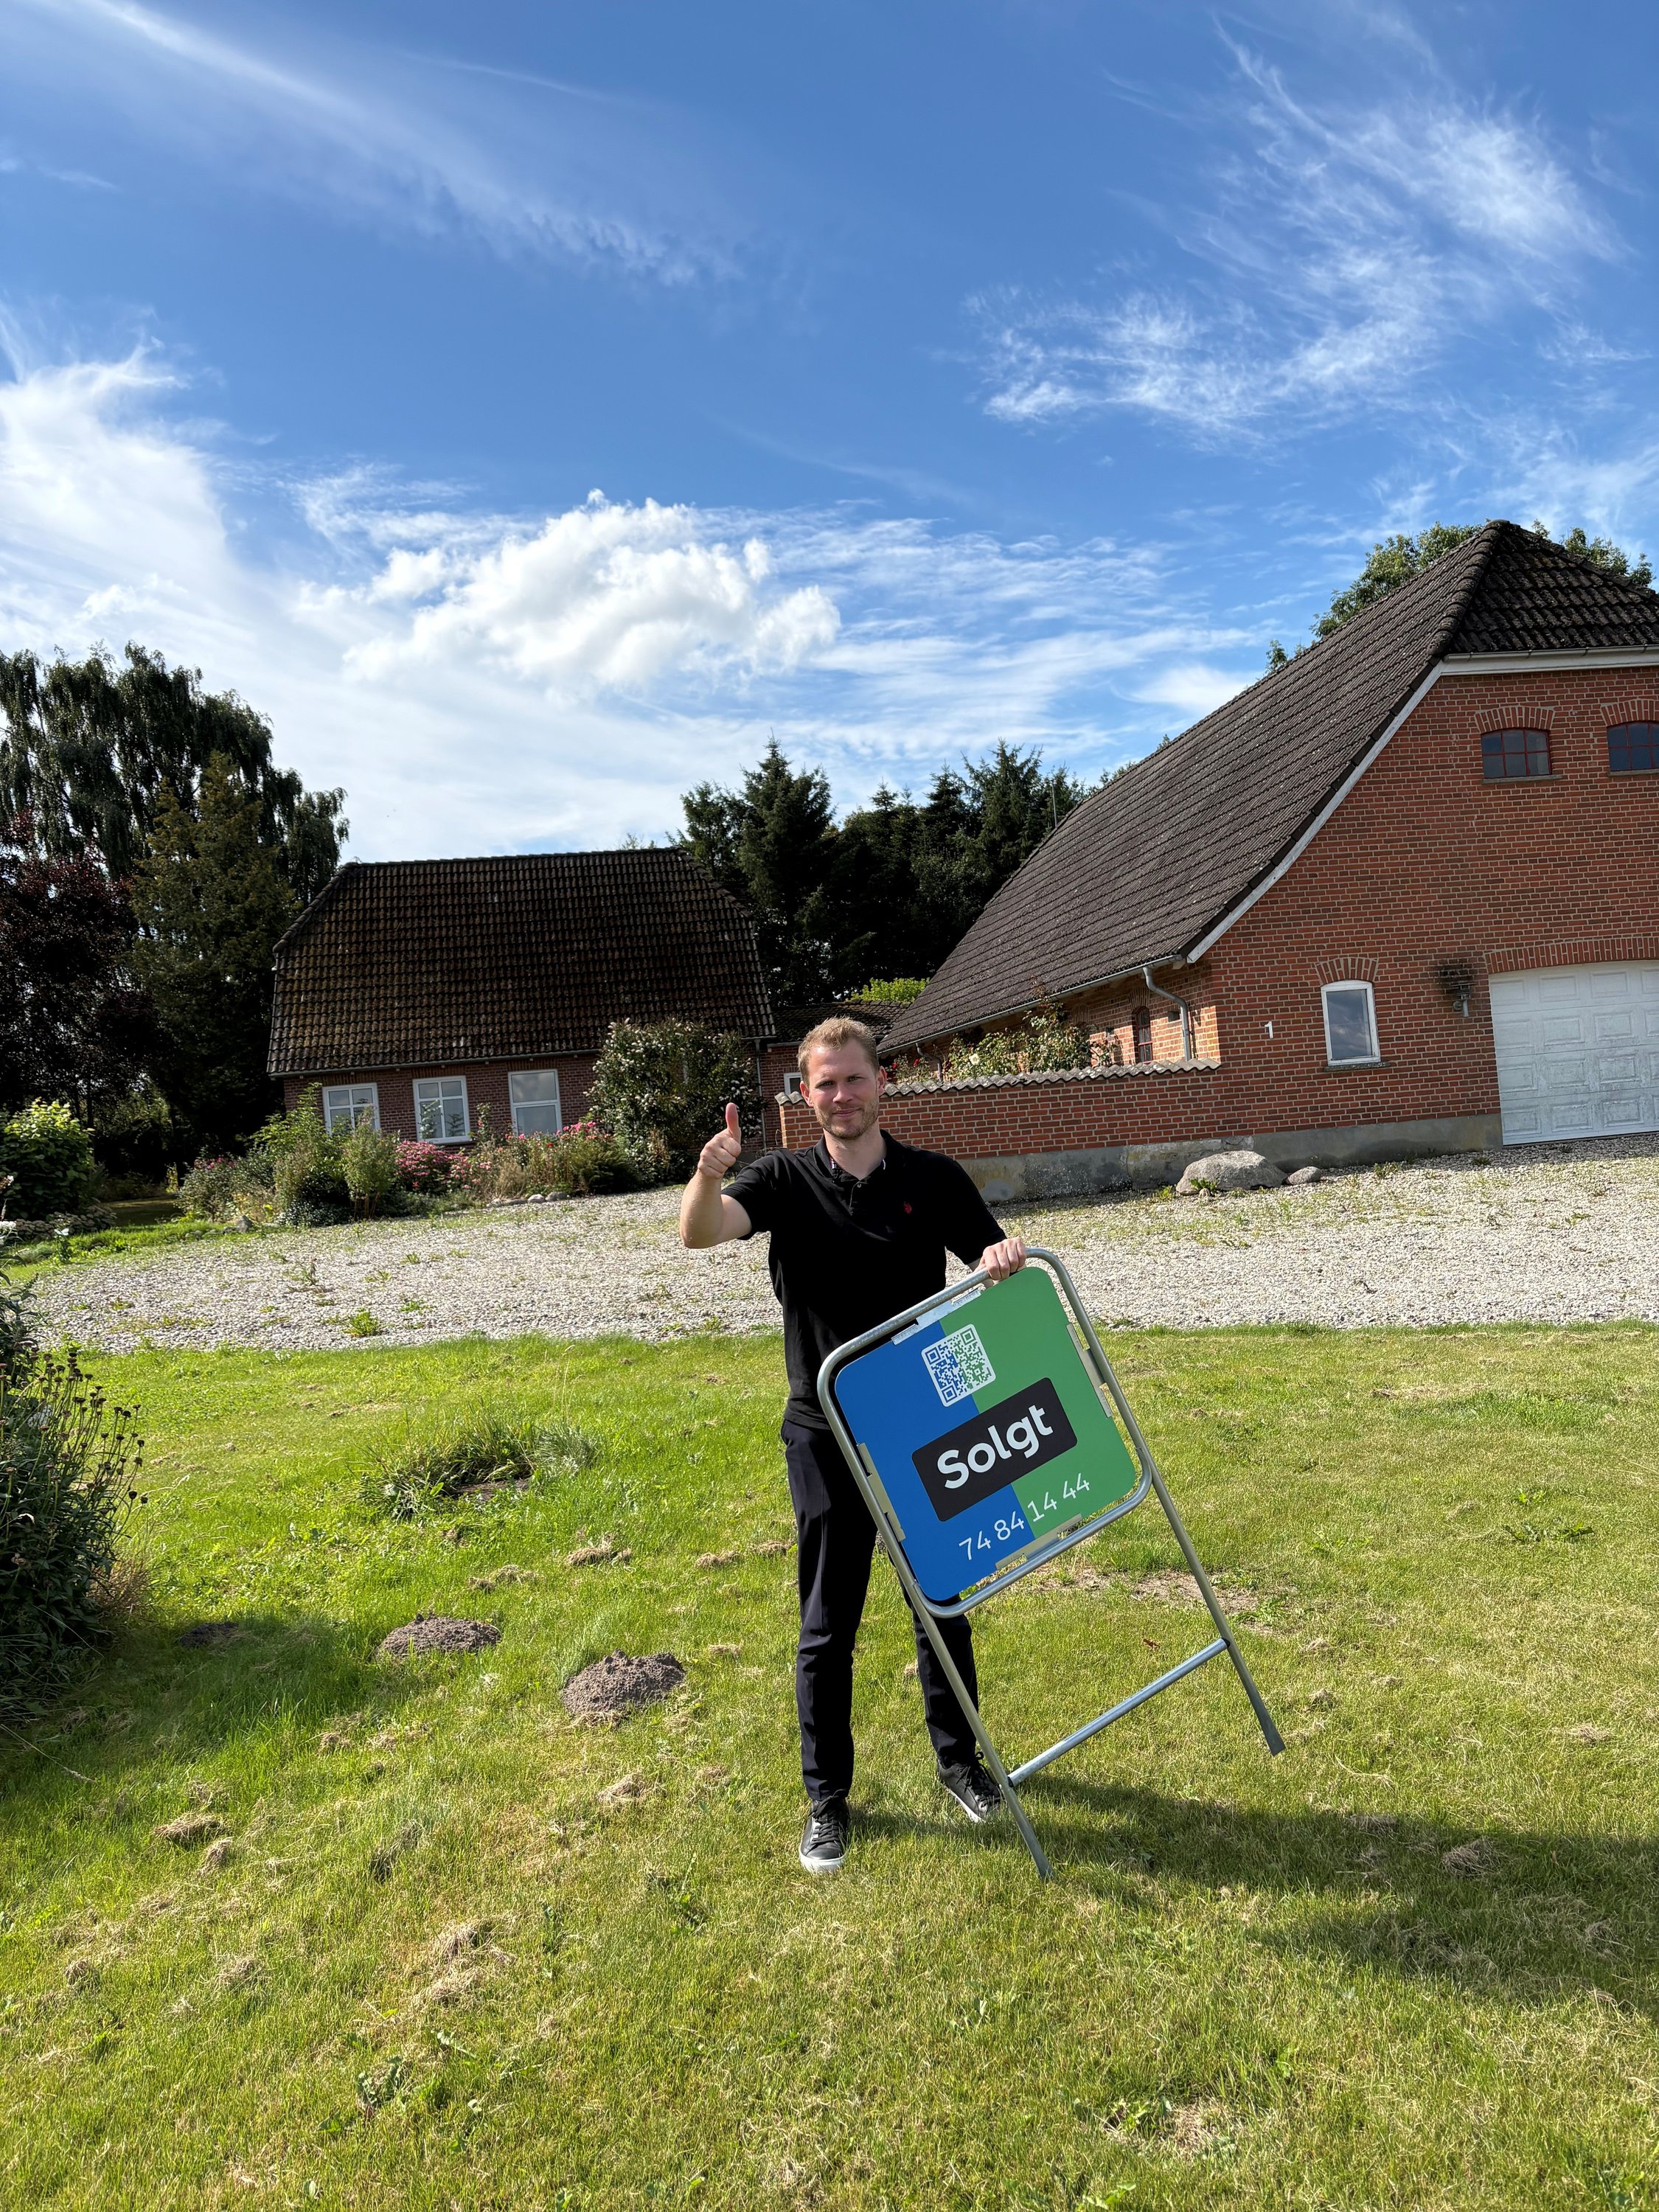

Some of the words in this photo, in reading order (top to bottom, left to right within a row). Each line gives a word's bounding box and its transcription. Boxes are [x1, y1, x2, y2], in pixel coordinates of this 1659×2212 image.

[1264, 1020, 1273, 1039] 1
[937, 1405, 1053, 1489] Solgt
[959, 1531, 991, 1560] 74
[994, 1511, 1025, 1540] 84
[1027, 1491, 1057, 1523] 14
[1062, 1472, 1091, 1499] 44
